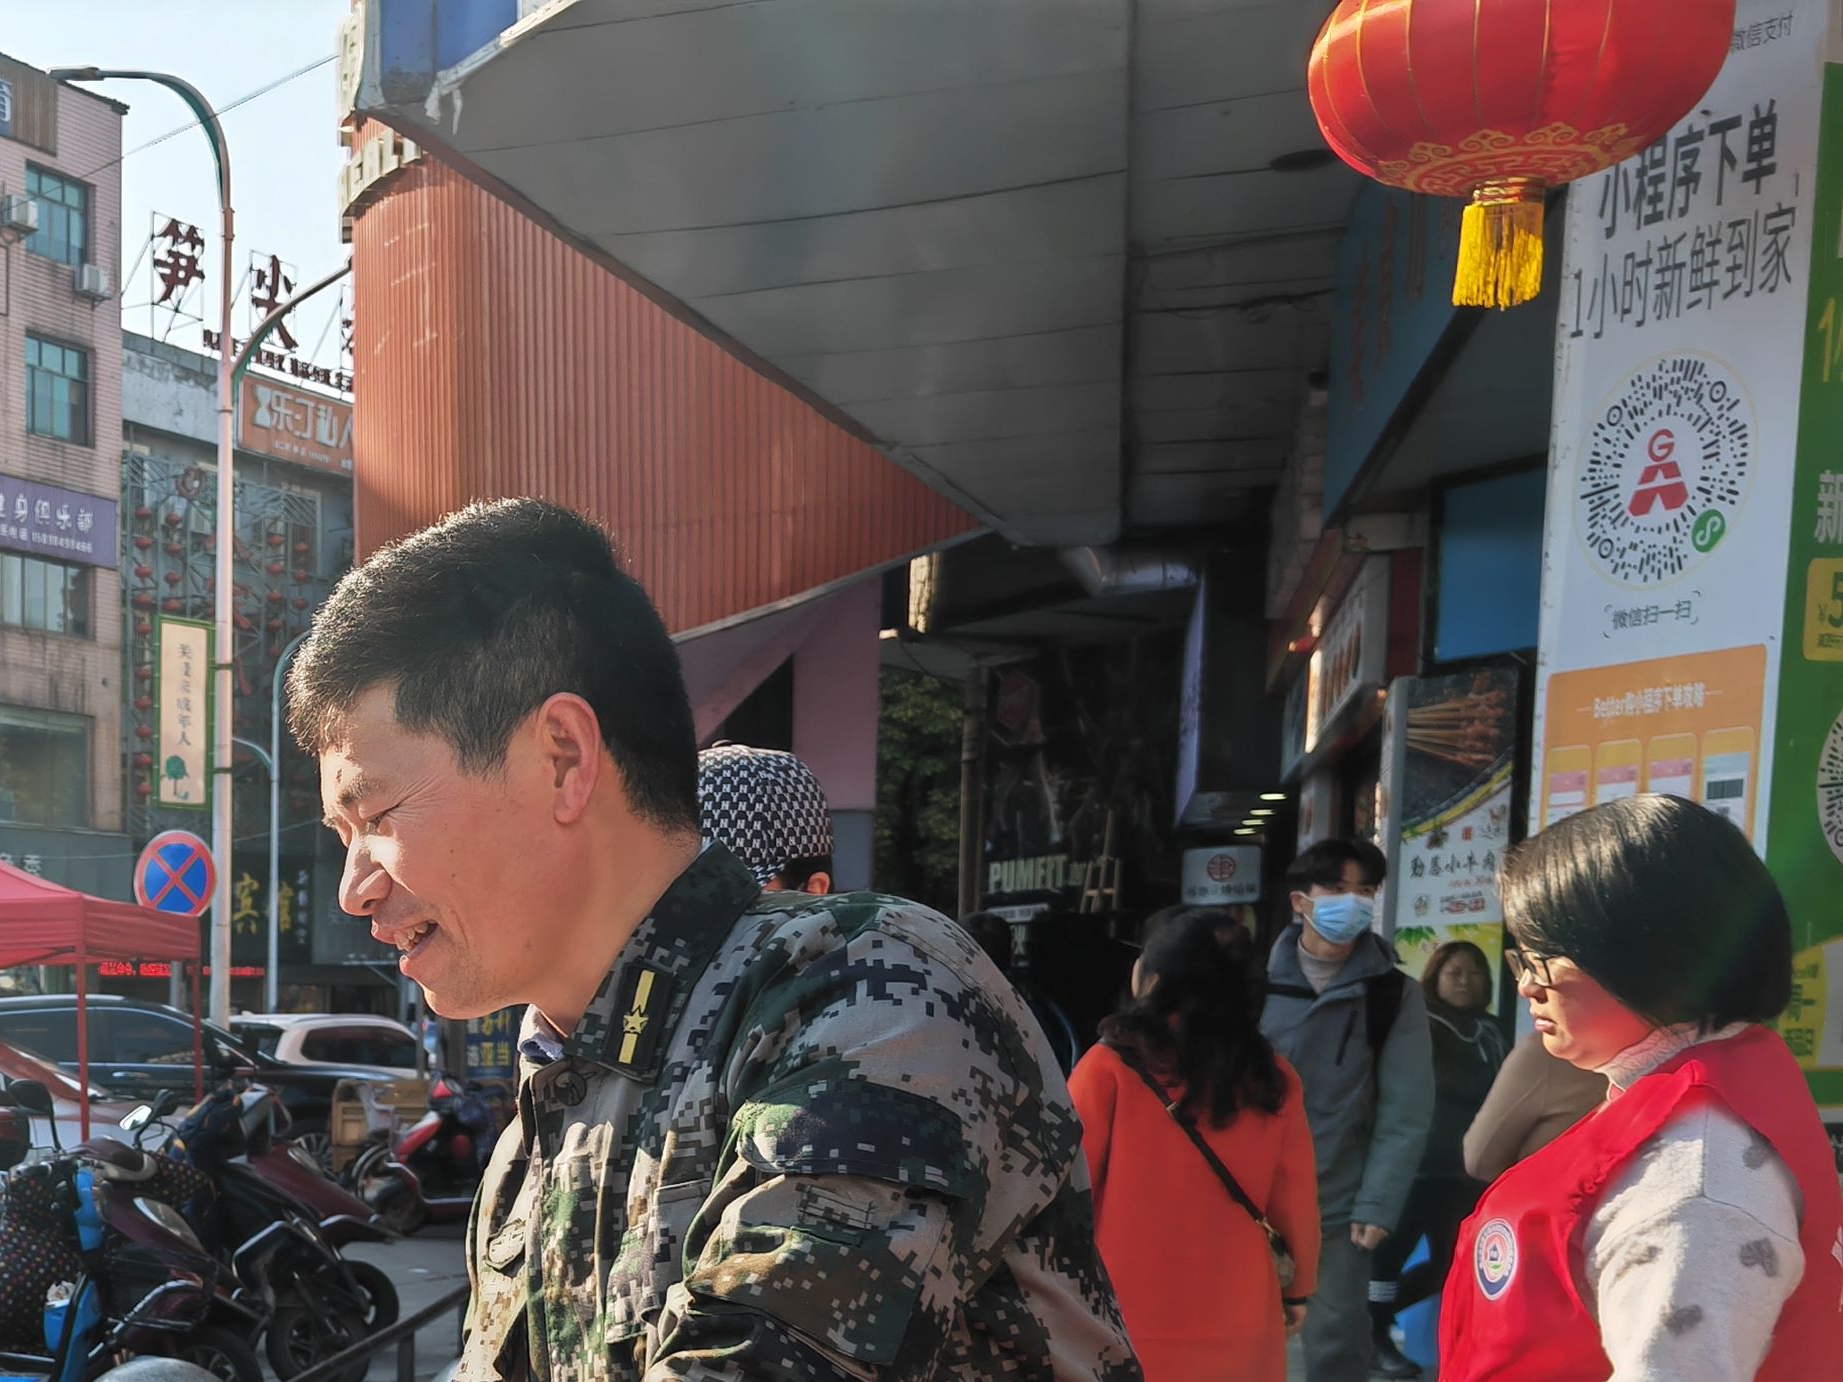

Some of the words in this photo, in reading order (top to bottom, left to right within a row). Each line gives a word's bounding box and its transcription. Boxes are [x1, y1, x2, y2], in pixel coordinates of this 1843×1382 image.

[1570, 203, 1797, 340] 1小时新鲜到家
[1612, 600, 1693, 631] 微信扫一扫
